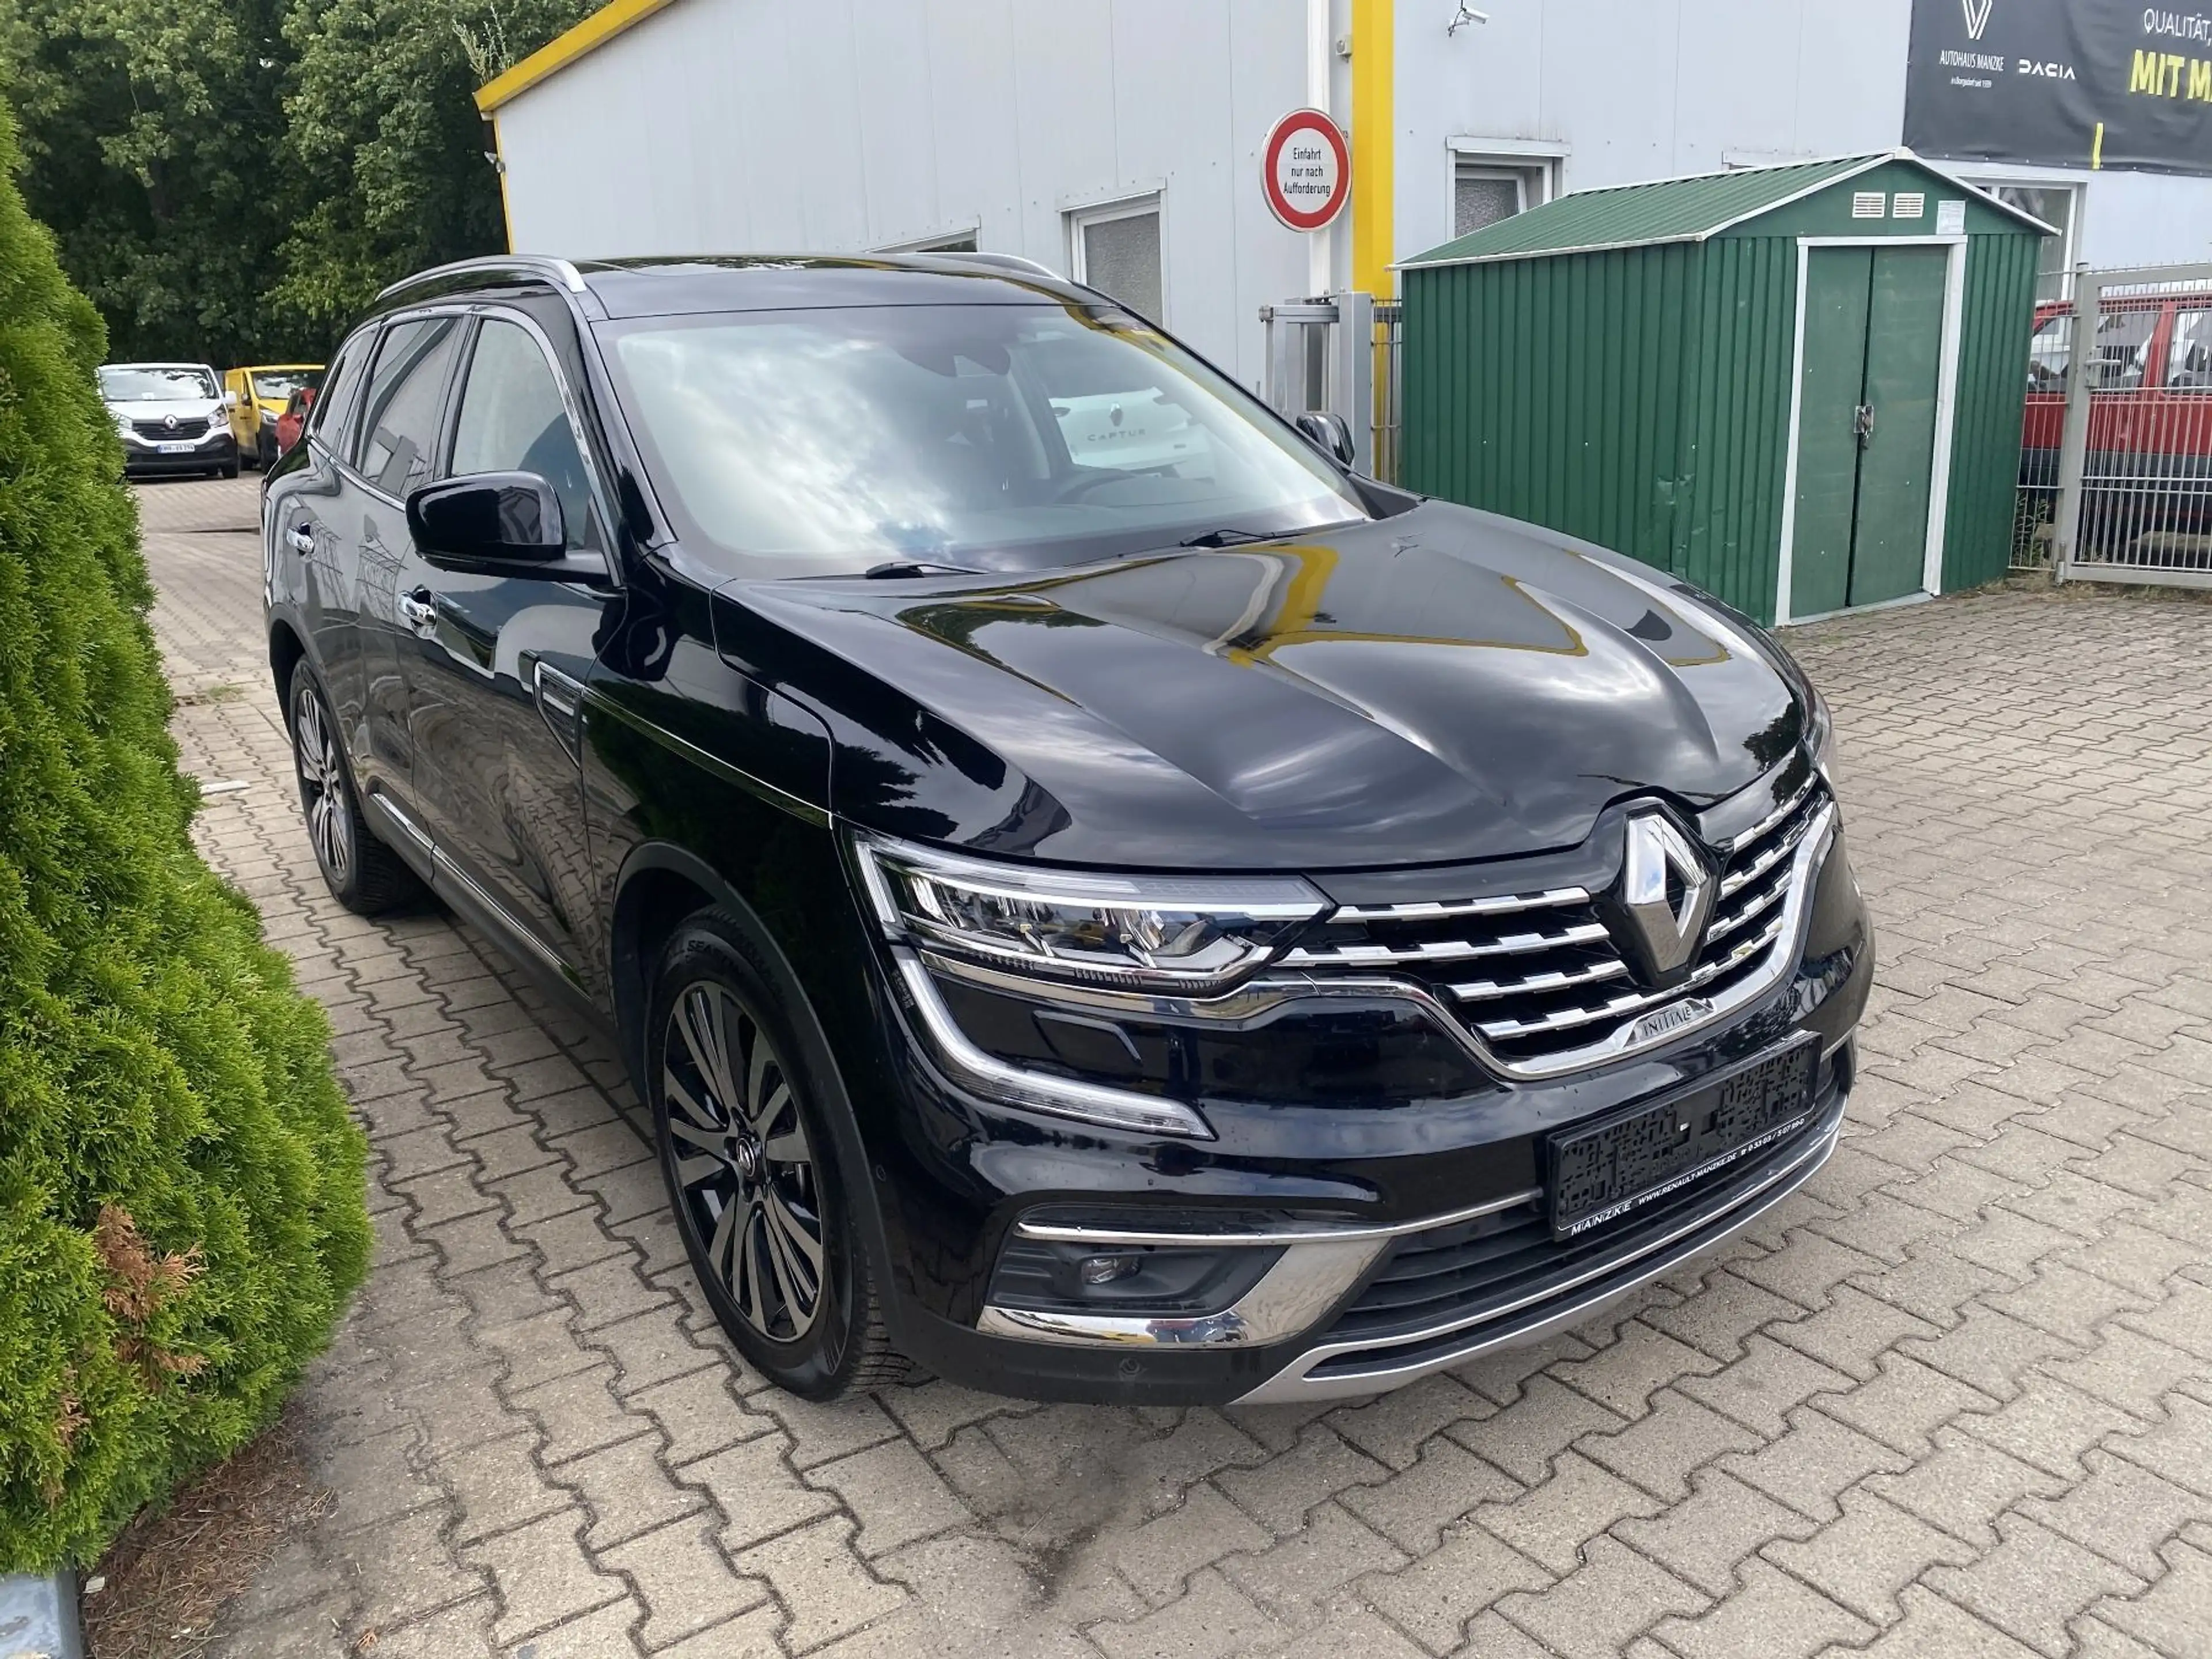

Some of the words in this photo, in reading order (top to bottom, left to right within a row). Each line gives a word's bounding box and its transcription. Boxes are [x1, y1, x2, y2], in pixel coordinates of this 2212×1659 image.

[2143, 9, 2211, 46] QUALITÄT,
[1939, 50, 1976, 68] AUTOHAUS
[1976, 54, 2004, 71] MANZKE
[2018, 58, 2076, 80] DACIA
[2130, 49, 2186, 98] MIT
[2187, 59, 2212, 103] M
[1293, 147, 1320, 160] Einfahrt
[1291, 168, 1303, 177] nur
[1305, 165, 1323, 177] nach
[1283, 181, 1331, 197] Aufforderung
[1086, 428, 1146, 441] CAPTUR
[1571, 1201, 1632, 1236] MANZKE
[1638, 1152, 1737, 1205] WWW.RENAULT-MANZKE.DE
